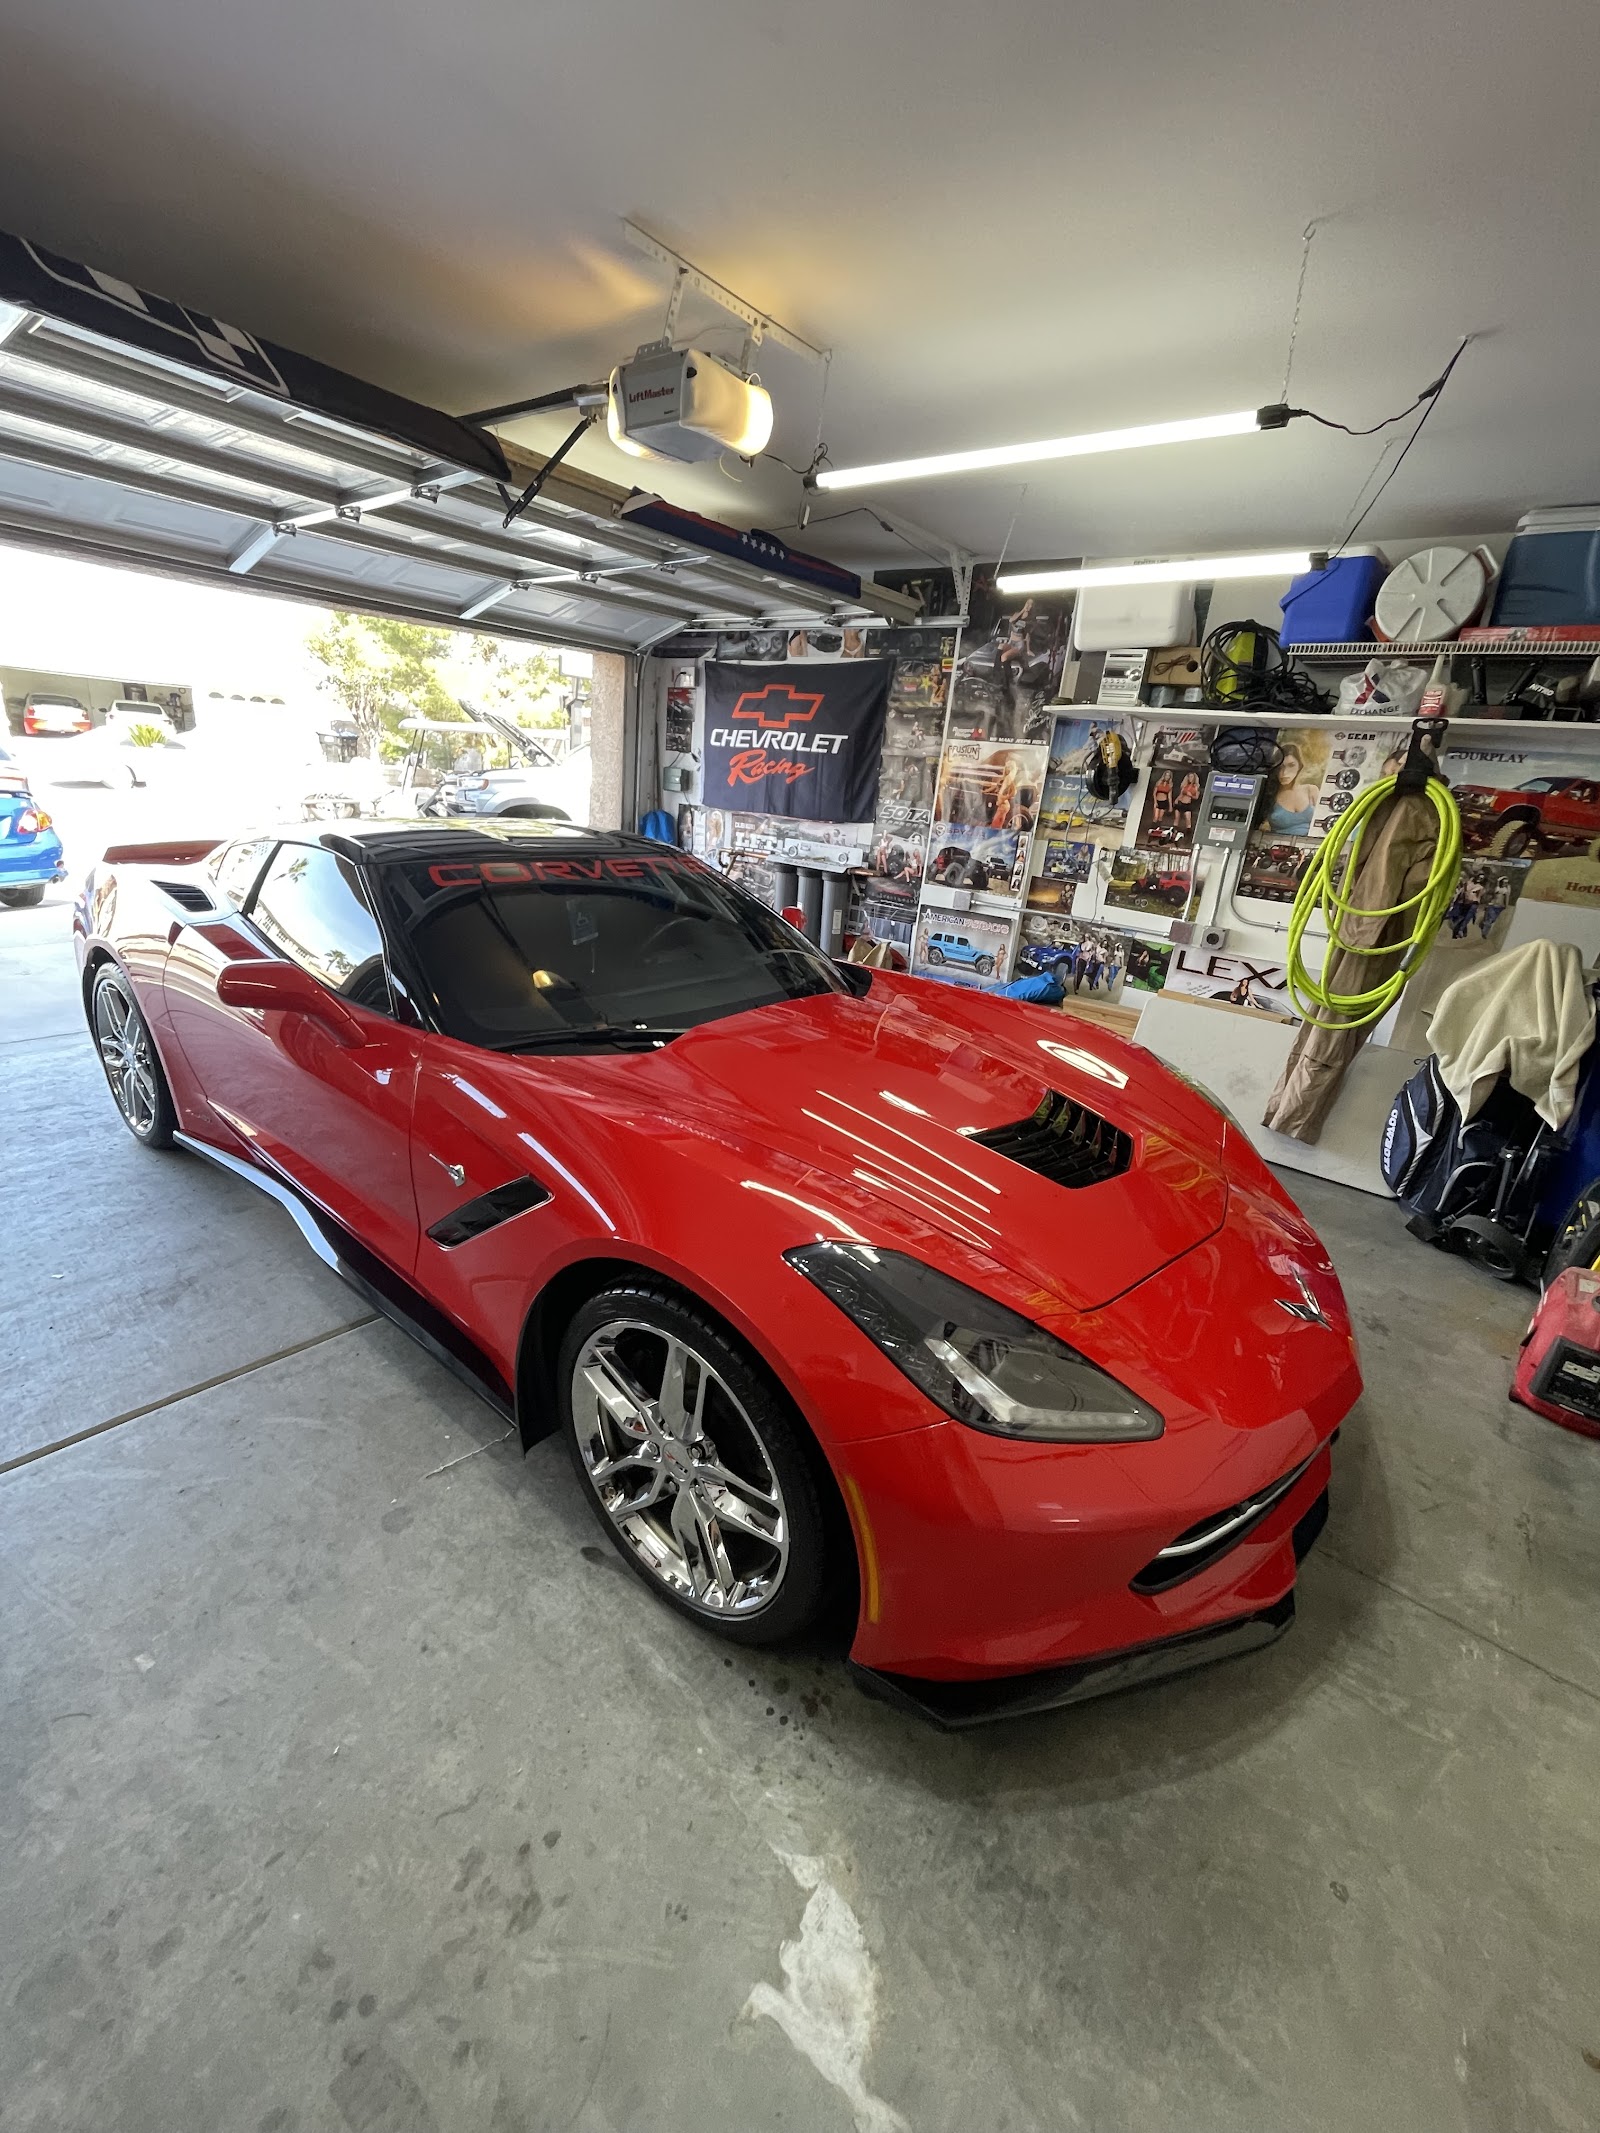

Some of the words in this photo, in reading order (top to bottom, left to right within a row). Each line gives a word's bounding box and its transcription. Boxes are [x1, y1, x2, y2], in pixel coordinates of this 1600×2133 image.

[628, 386, 675, 403] LiftMaster
[1350, 705, 1400, 716] EXCHANGE
[710, 728, 848, 754] CHEVROLET
[727, 749, 816, 787] Racing
[879, 805, 931, 824] SOTA
[923, 910, 965, 925] AMERICAN
[1383, 1108, 1399, 1175] COWBOYS
